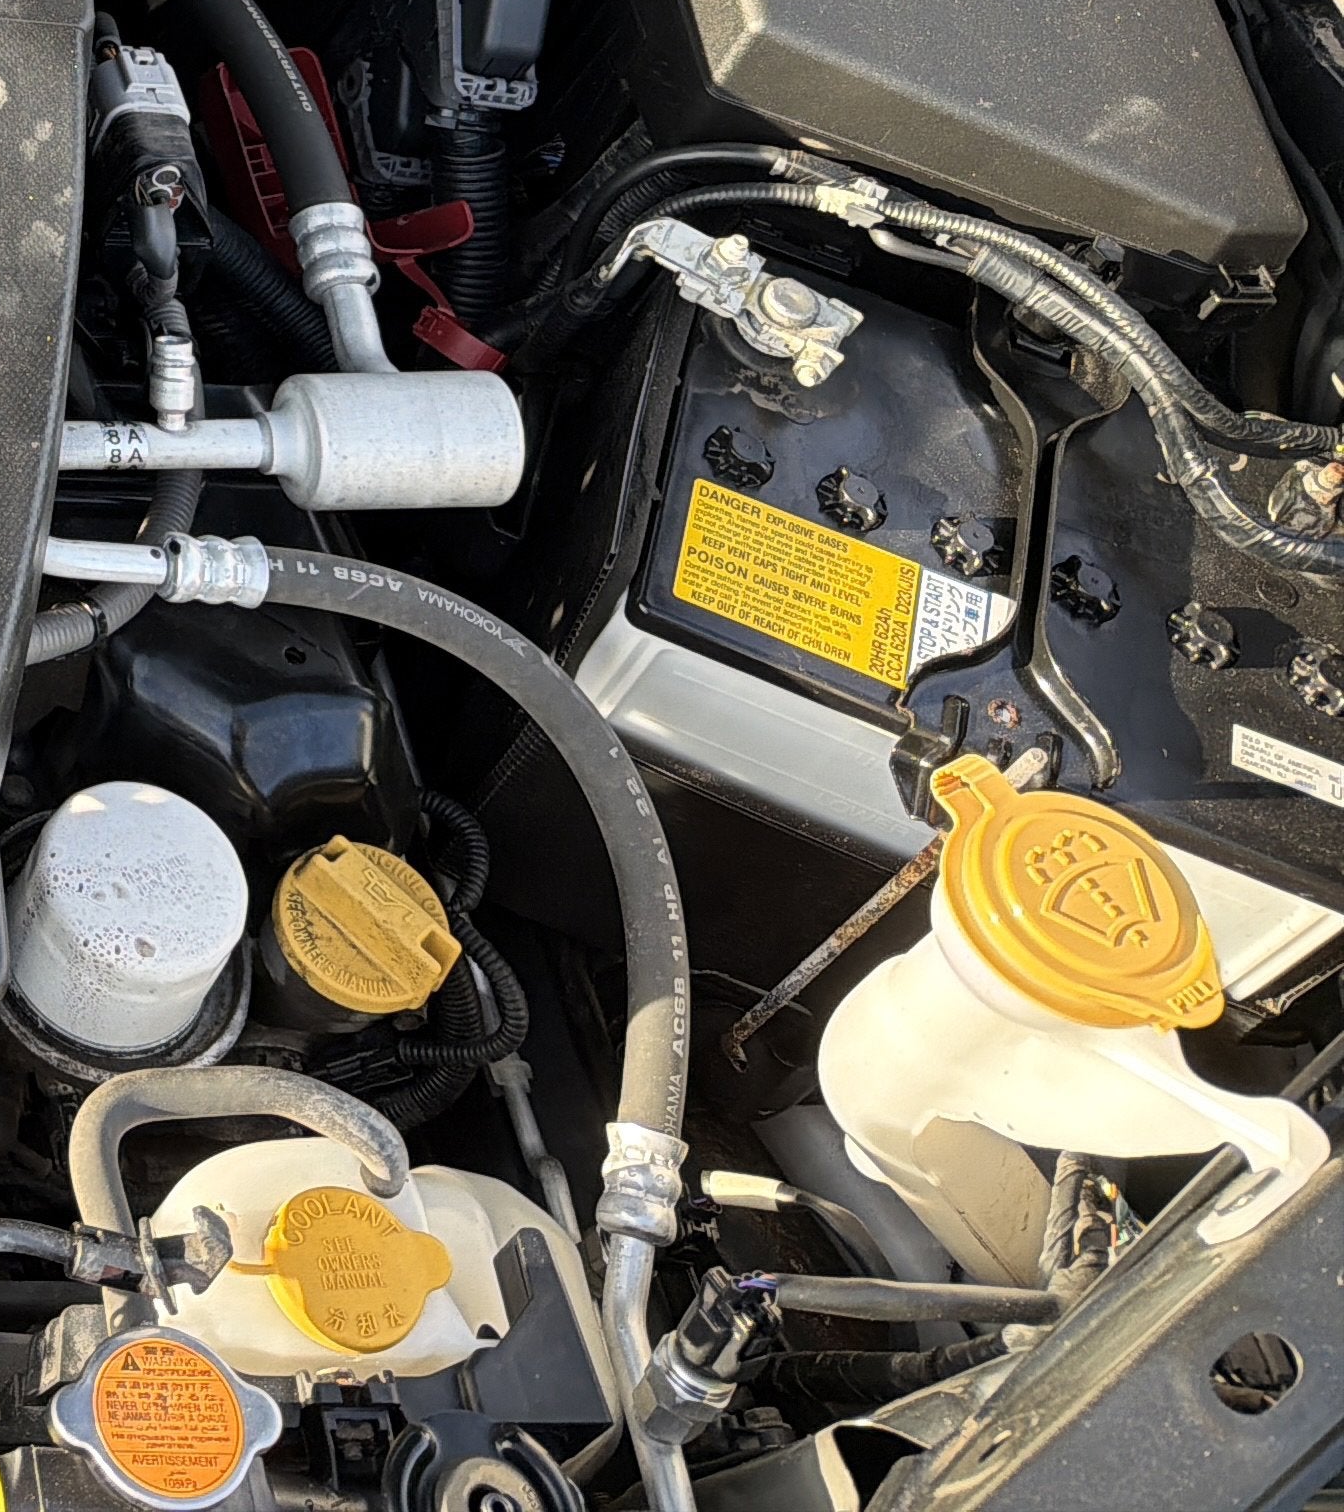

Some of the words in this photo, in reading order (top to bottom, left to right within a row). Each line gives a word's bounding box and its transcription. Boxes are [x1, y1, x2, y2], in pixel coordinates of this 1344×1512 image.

[699, 485, 761, 519] DANGER
[766, 513, 814, 540] EXPLOSIVE
[817, 533, 848, 553] GASES
[296, 560, 320, 576] 11
[702, 534, 724, 551] KEEP
[727, 544, 750, 562] VENT
[753, 554, 777, 572] CAPS
[779, 565, 807, 585] TIGHT
[810, 578, 830, 594] AND
[686, 545, 748, 579] POISON
[752, 573, 789, 596] CAUSES
[792, 589, 827, 611] SEVERE
[829, 604, 862, 625] BURNS
[923, 575, 944, 617] START
[417, 586, 505, 639] YOKOHAMA
[690, 589, 713, 606] KEEP
[716, 599, 736, 615] OUT
[738, 608, 751, 621] OF
[752, 614, 785, 636] REACH
[786, 628, 798, 641] OF
[801, 634, 850, 662] CHILDREN
[877, 607, 893, 640] 62Ah
[890, 620, 909, 651] 620A
[917, 627, 938, 660] STOP
[868, 640, 889, 676] 20HR
[885, 651, 902, 682] CCA
[626, 777, 651, 817] 22
[365, 848, 425, 895] NGINE
[664, 883, 679, 921] HP
[288, 918, 336, 977] OWNER'S
[336, 969, 400, 998] MANUAL
[671, 935, 684, 962] 11
[1167, 980, 1213, 1015] PULL
[664, 1074, 682, 1141] OHAMA
[284, 1193, 402, 1246] COOLANT
[317, 1253, 383, 1272] OWNERS
[322, 1237, 356, 1254] SEE
[320, 1271, 385, 1291] MANUAL
[141, 1356, 199, 1367] WARNING
[106, 1400, 138, 1411] NEVER
[132, 1454, 219, 1467] AVERTISSEMENT
